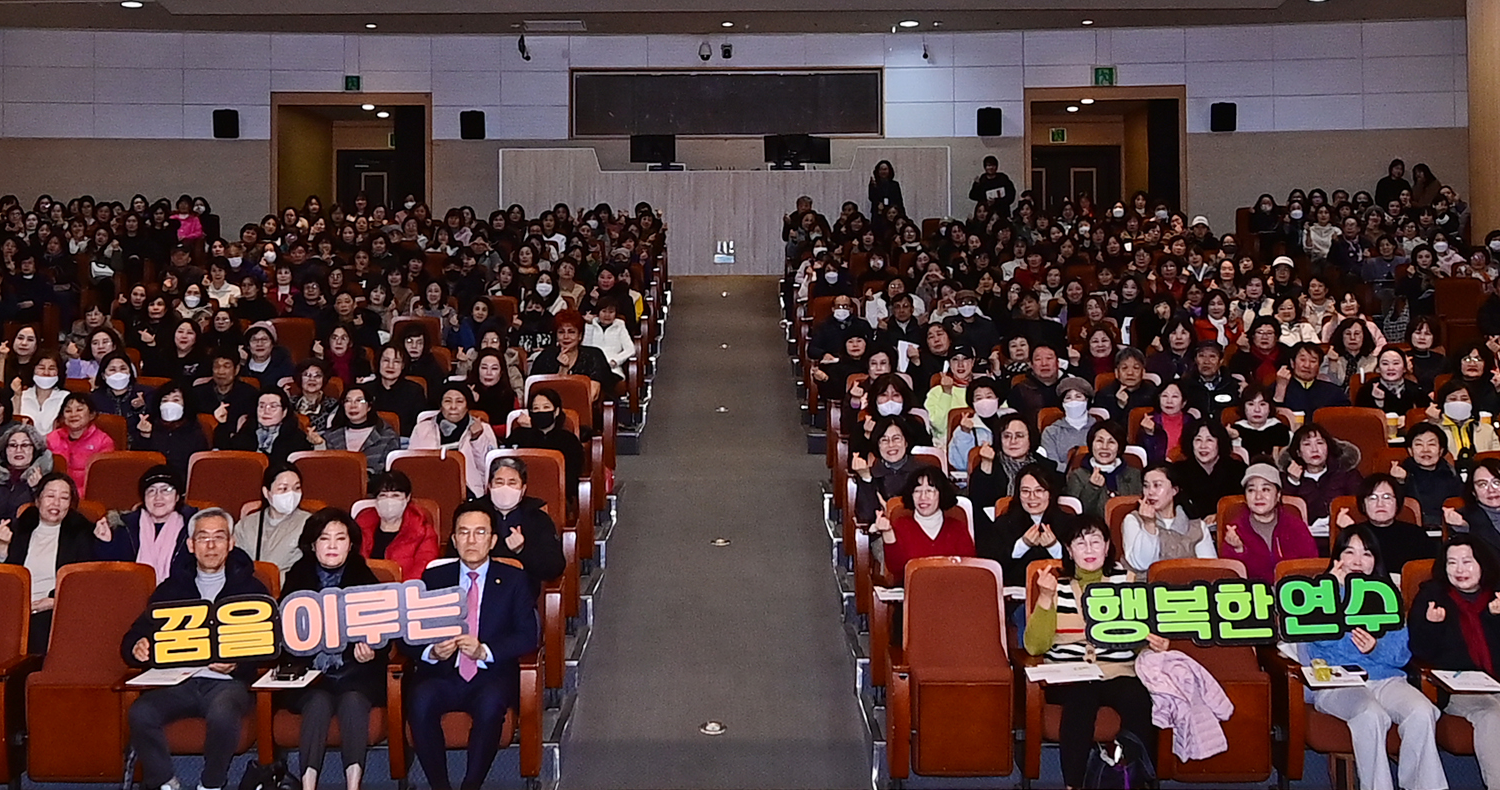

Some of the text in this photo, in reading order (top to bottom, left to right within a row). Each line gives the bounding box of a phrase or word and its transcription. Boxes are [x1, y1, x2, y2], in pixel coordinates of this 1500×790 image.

[151, 585, 463, 664] 꿈을 이루는
[1086, 577, 1401, 644] 행복한 연수
